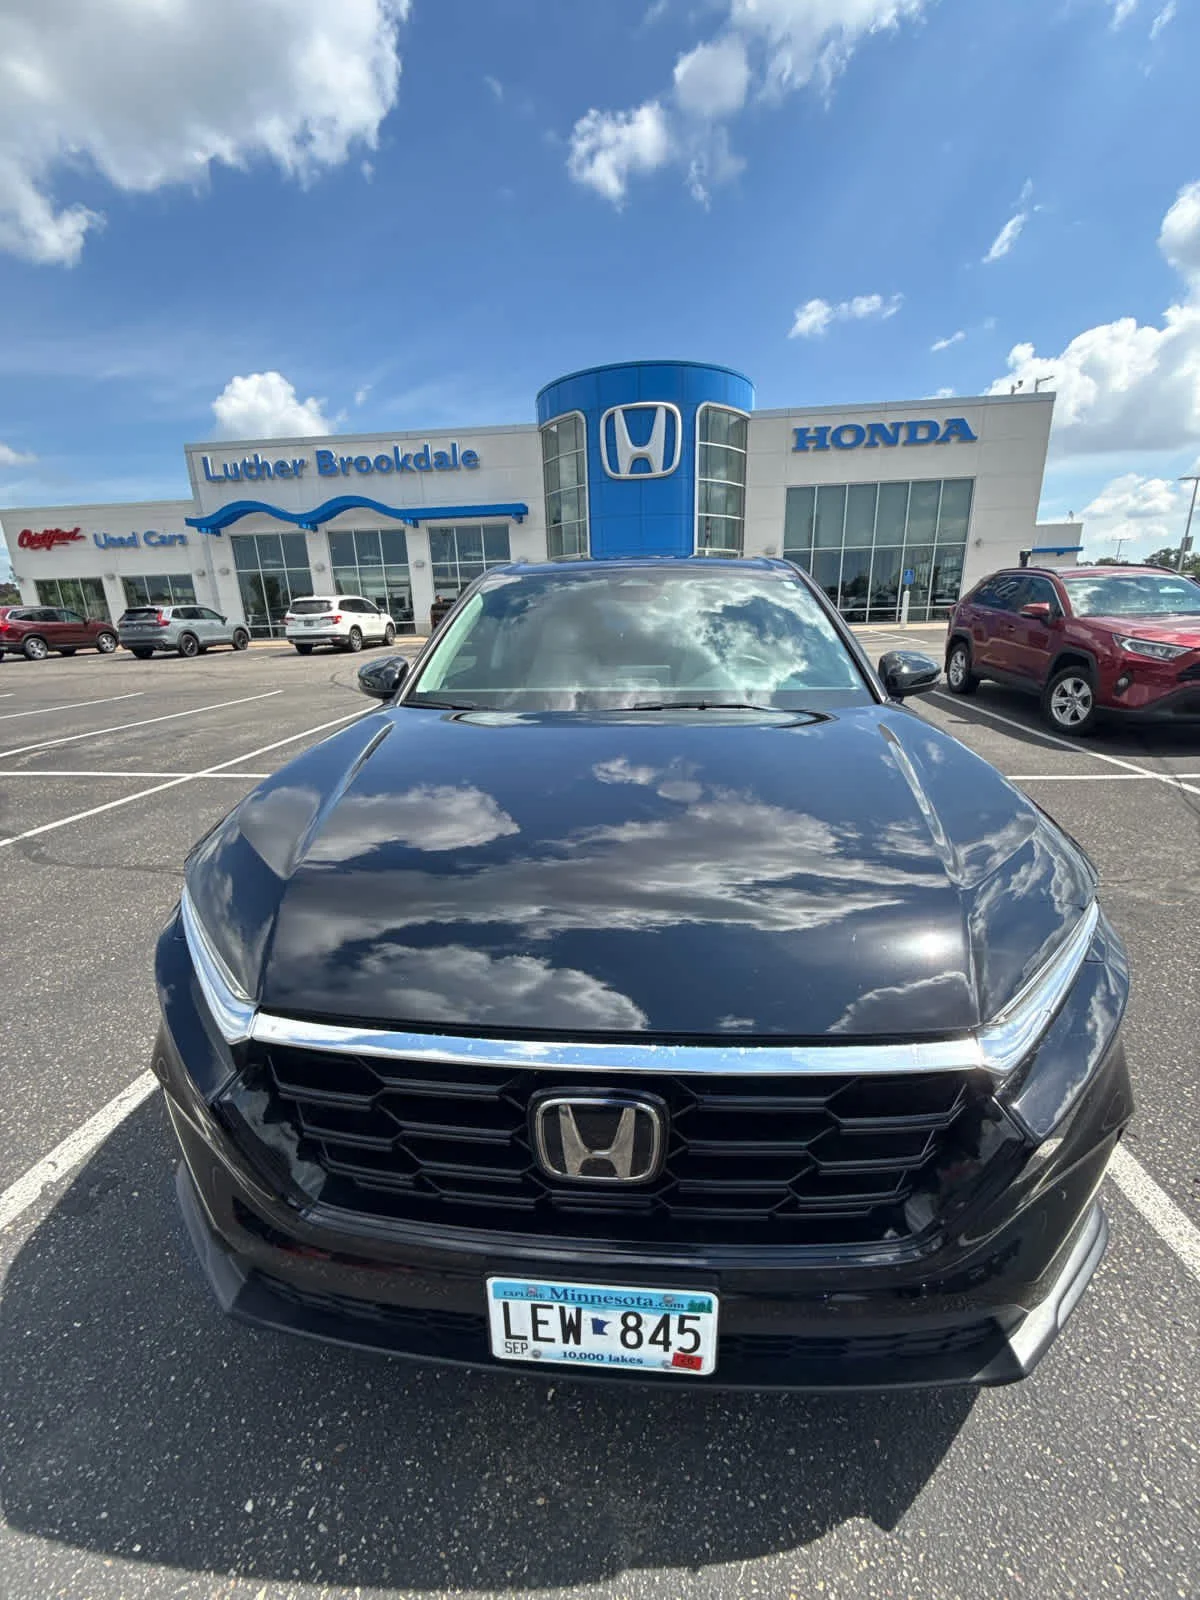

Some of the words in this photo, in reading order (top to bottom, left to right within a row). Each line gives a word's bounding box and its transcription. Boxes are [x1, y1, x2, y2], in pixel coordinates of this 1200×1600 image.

[792, 418, 978, 452] HONDA
[202, 453, 305, 481] Luther
[316, 443, 479, 476] Brookdale
[93, 532, 139, 549] Used
[144, 531, 187, 546] Cars
[502, 1301, 582, 1346] LEW
[620, 1311, 701, 1354] 845
[504, 1341, 528, 1354] SEP
[563, 1351, 604, 1361] 10,000
[608, 1353, 644, 1364] lakes
